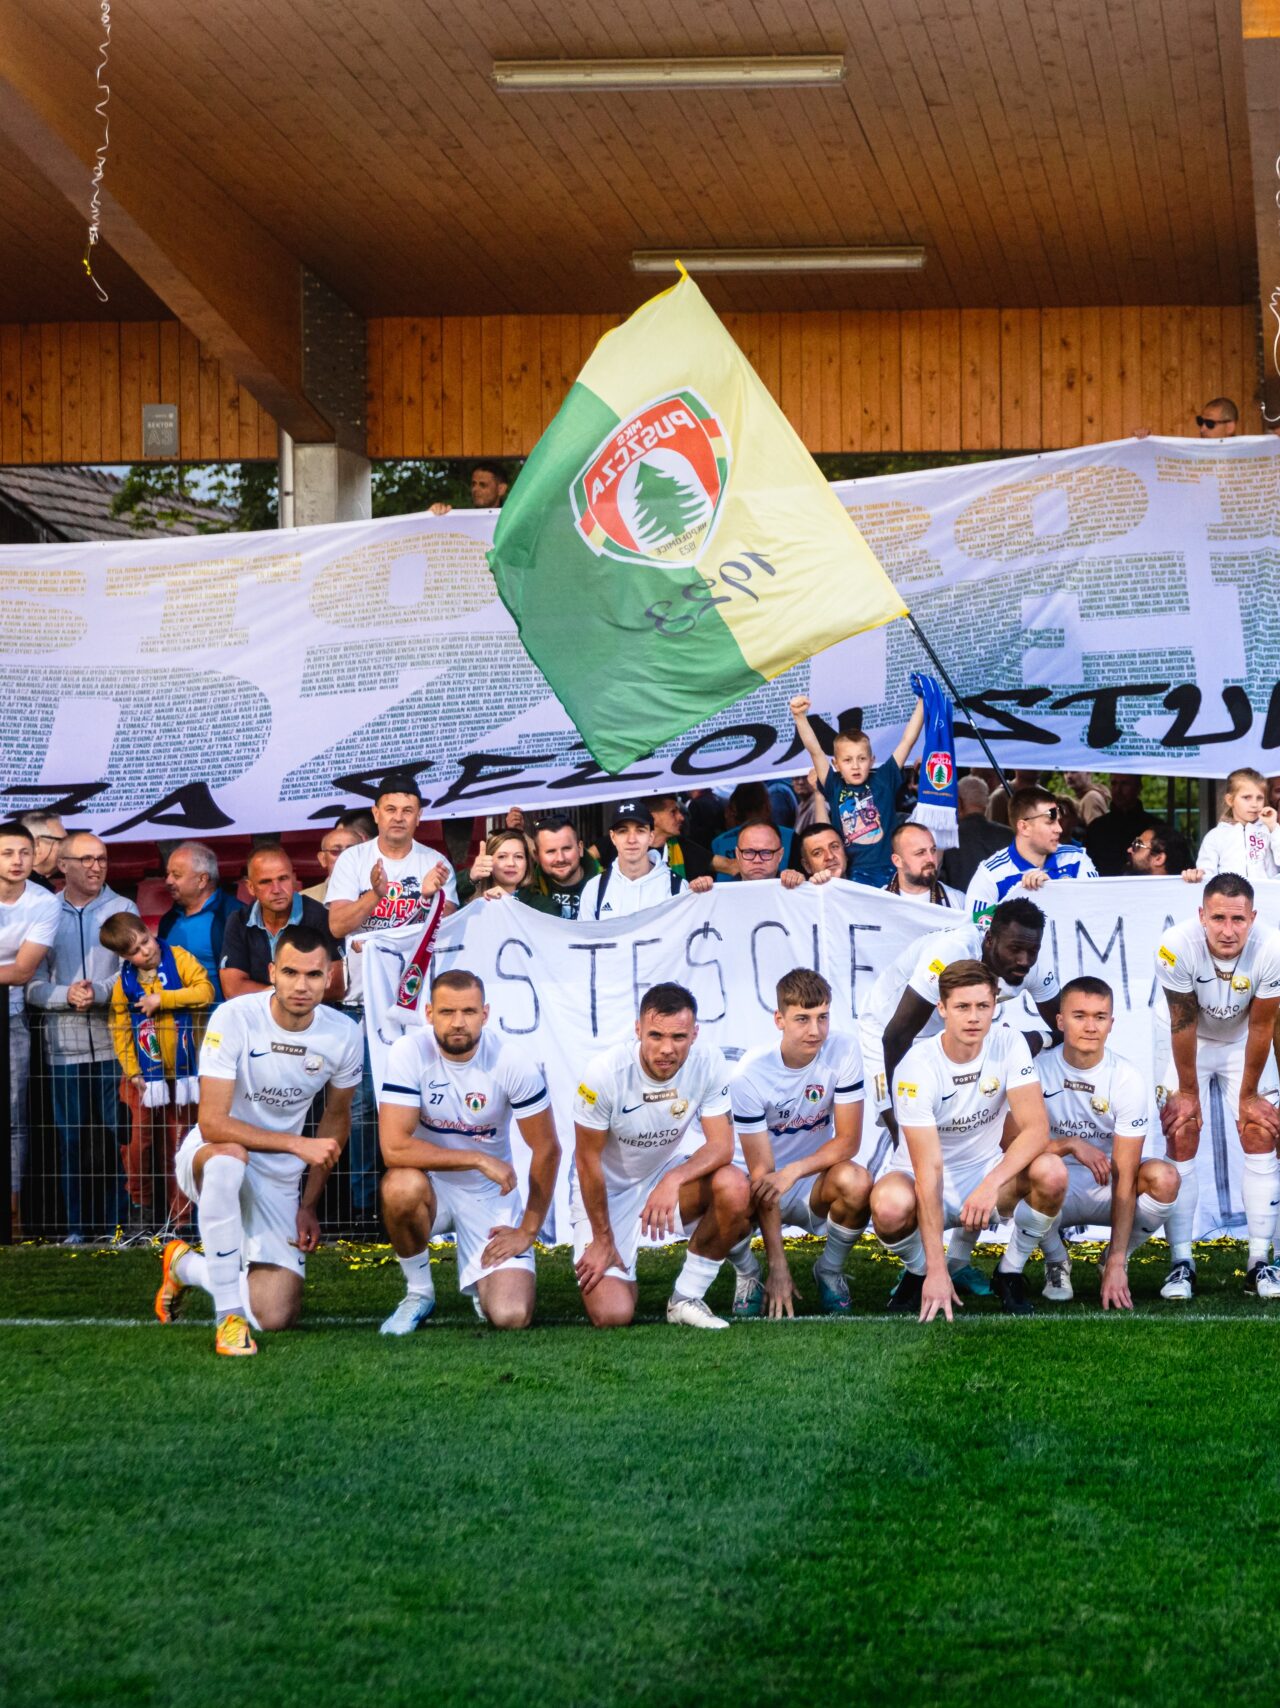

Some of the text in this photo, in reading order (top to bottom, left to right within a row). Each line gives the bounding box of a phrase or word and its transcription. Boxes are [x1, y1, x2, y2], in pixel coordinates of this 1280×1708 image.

[272, 1043, 305, 1055] FORTUNA
[261, 1086, 303, 1098] MIASTO
[645, 1091, 676, 1101] FORTUNA
[429, 1093, 444, 1106] 27
[779, 1109, 790, 1119] 18
[951, 1108, 990, 1125] MIASTO
[1059, 1120, 1097, 1130] MIASTO
[638, 1128, 679, 1140] MIASTO
[1050, 1126, 1113, 1140] IEPOŁOMICE
